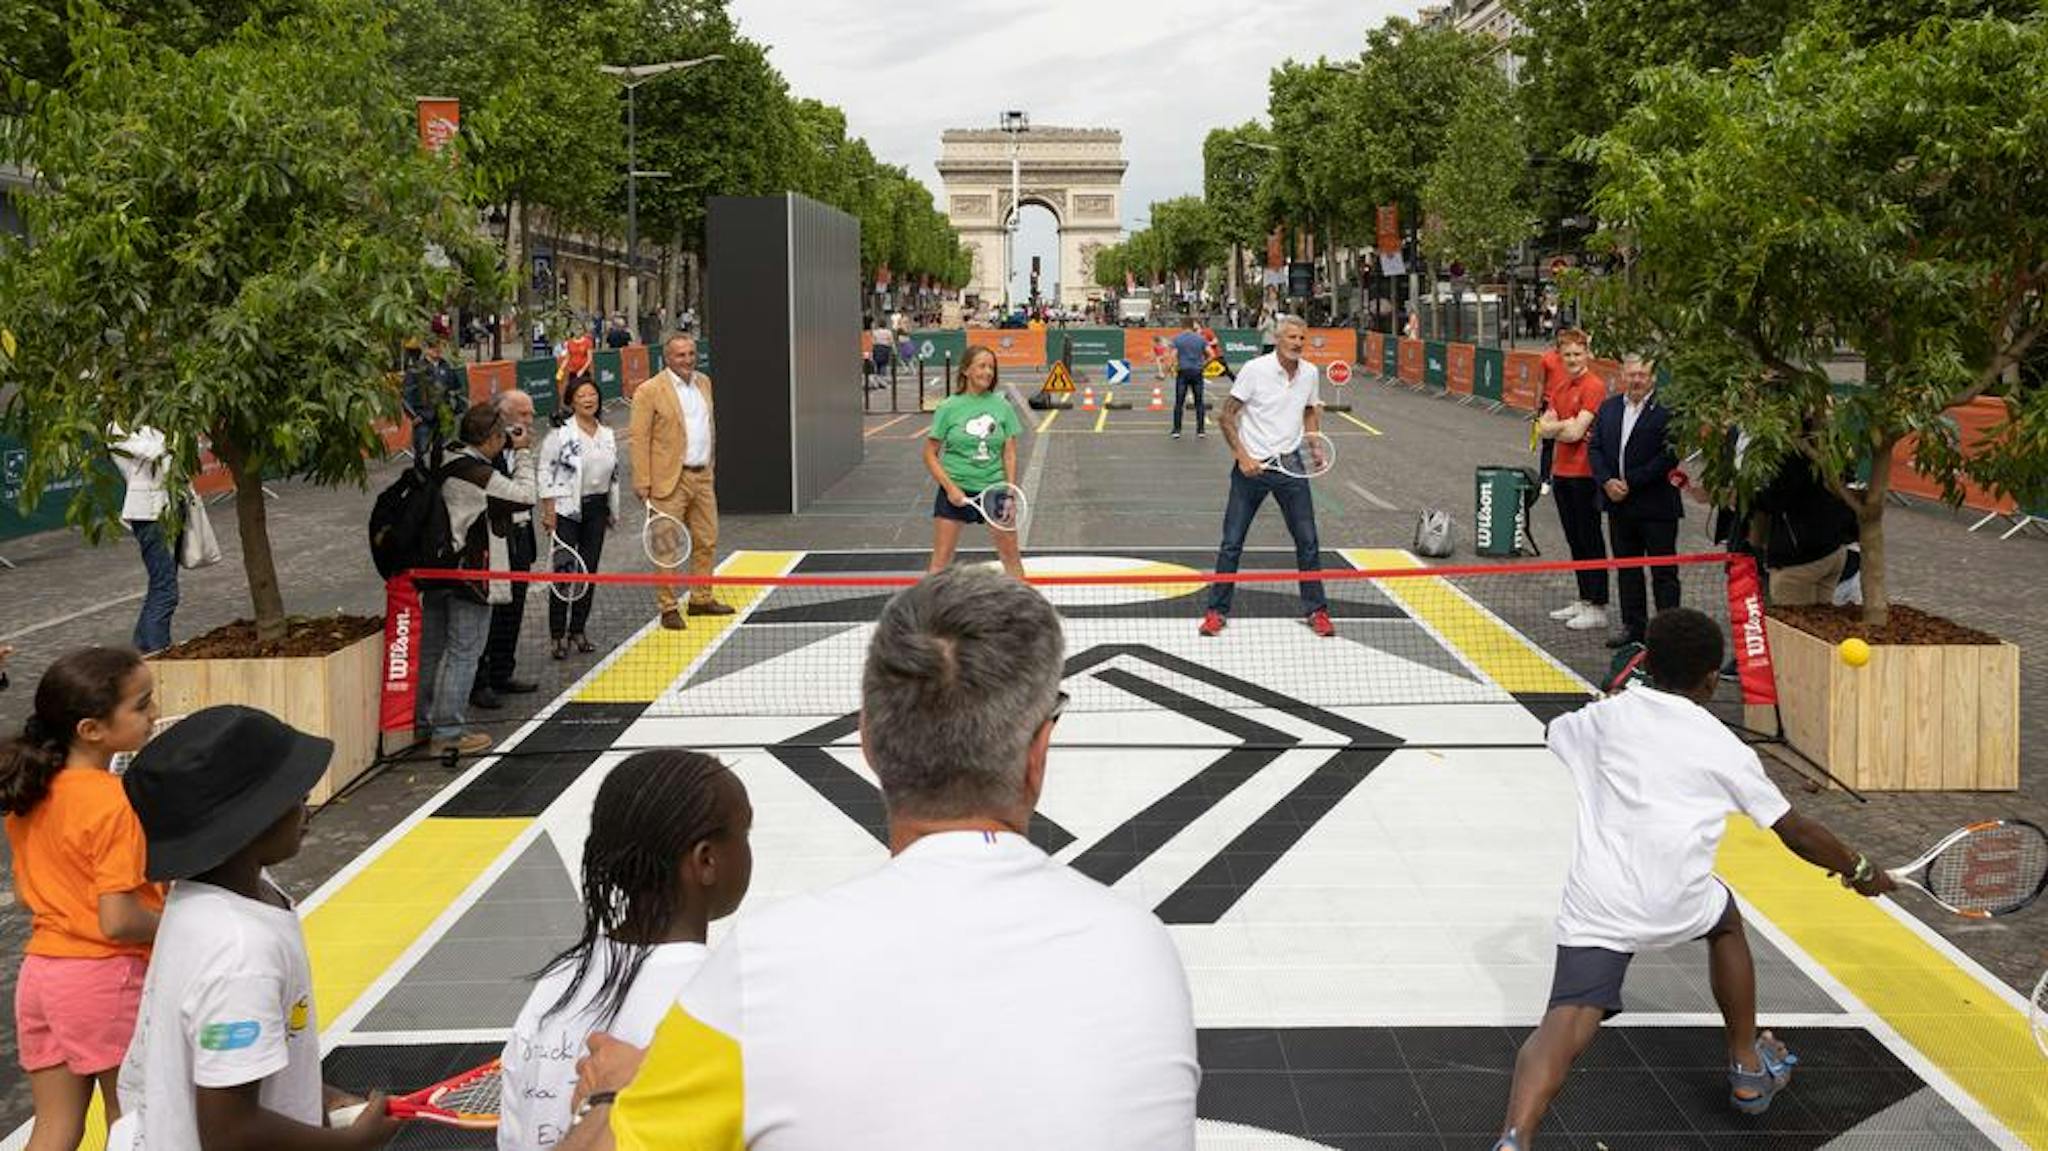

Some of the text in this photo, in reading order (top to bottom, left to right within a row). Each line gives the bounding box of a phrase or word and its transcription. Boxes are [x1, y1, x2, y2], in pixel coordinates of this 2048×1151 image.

[1478, 481, 1493, 548] Wilson
[389, 610, 411, 681] Wilson
[1744, 595, 1765, 656] Wilson
